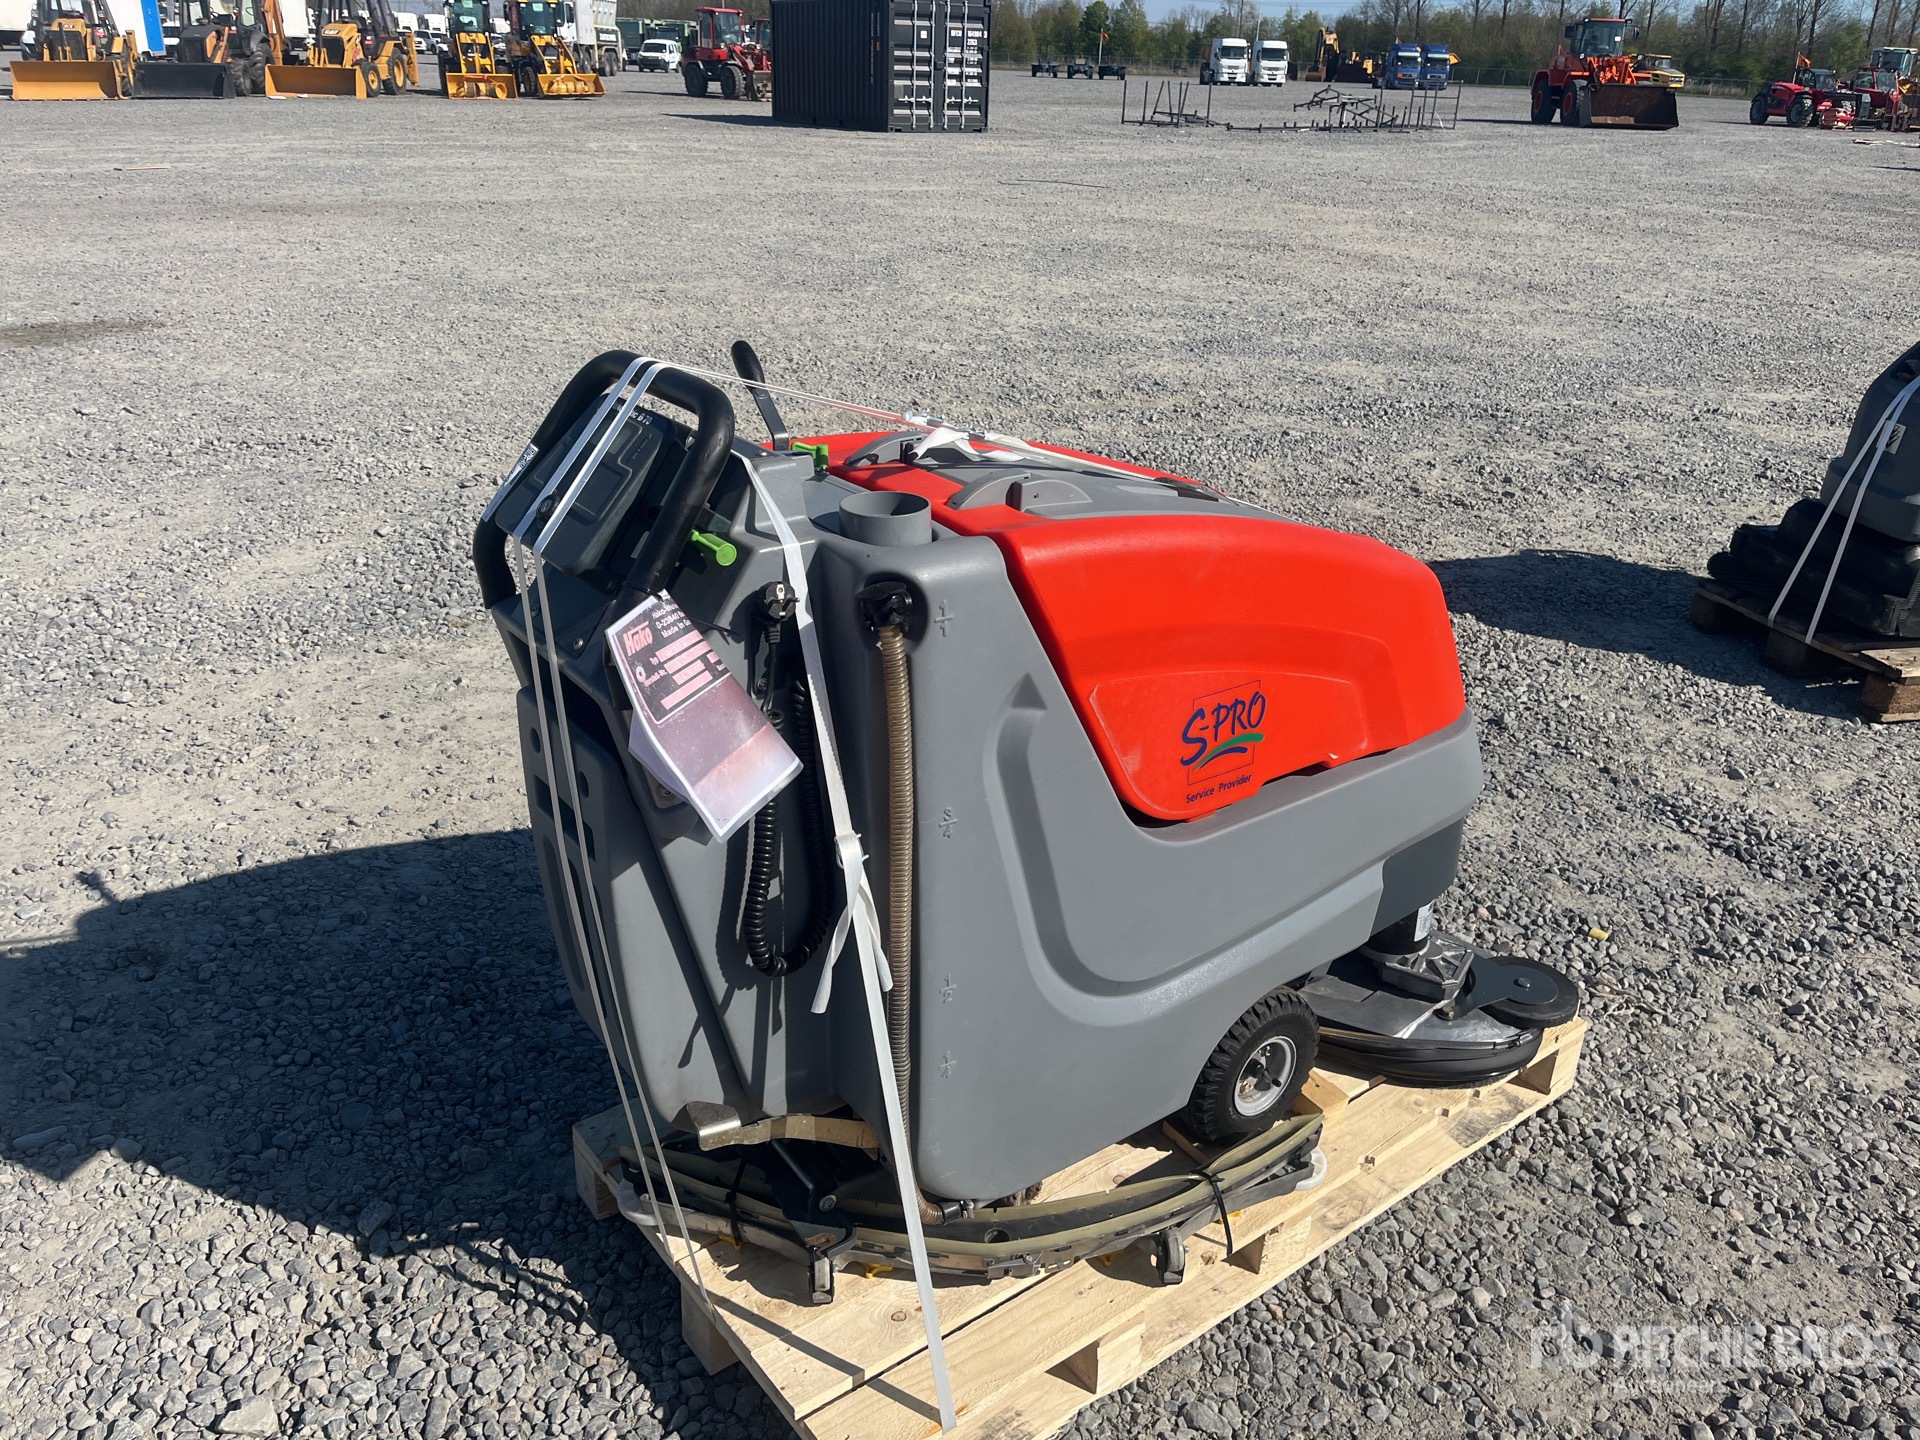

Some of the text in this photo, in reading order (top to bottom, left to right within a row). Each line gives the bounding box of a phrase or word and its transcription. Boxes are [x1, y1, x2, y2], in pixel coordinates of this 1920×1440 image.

[622, 620, 653, 657] Hako
[660, 625, 679, 639] Made
[1180, 690, 1266, 767] S-PRO
[1186, 774, 1252, 804] Service Provider
